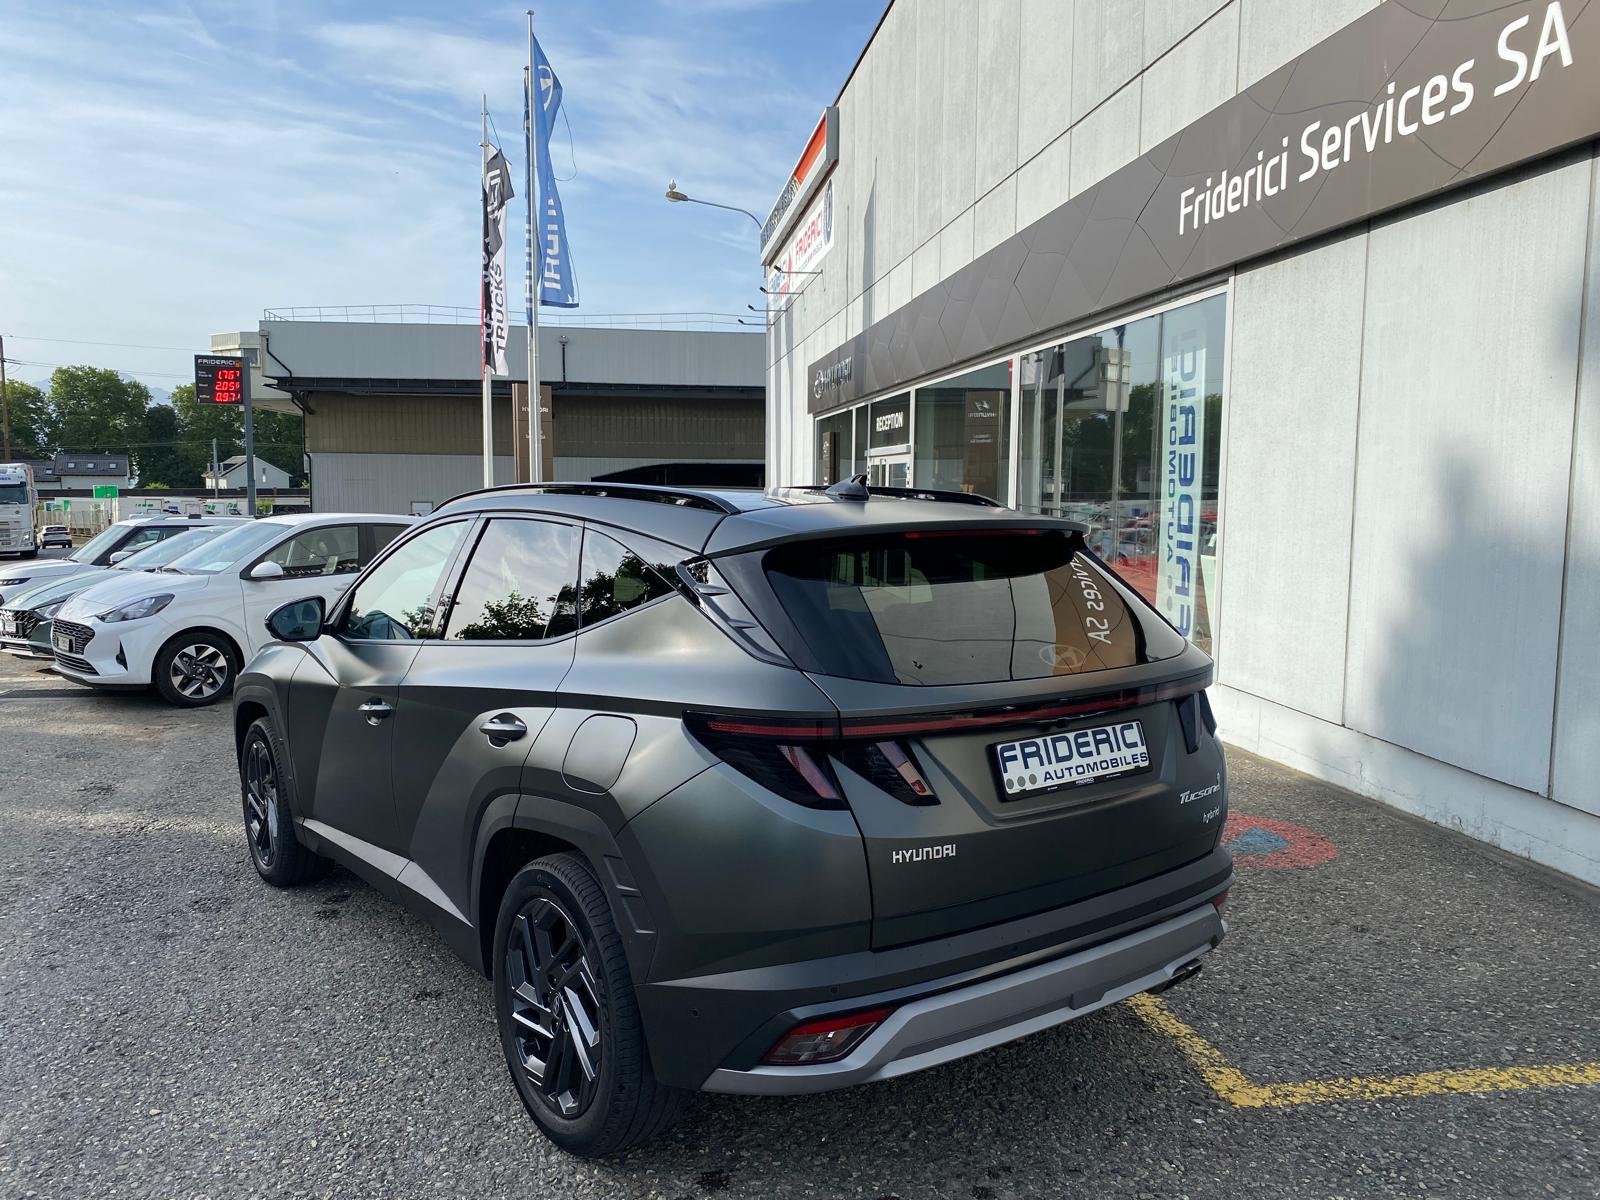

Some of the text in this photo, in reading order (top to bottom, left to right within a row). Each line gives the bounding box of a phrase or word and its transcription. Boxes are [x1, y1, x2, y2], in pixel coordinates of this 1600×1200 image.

[1179, 1, 1573, 236] Friderici Services SA
[495, 263, 504, 354] TRUCKS
[876, 411, 904, 432] RECEPTION
[999, 722, 1146, 774] FRIDERICI
[1043, 752, 1149, 783] AUTOMOBILES
[892, 843, 956, 864] HYUNDAI
